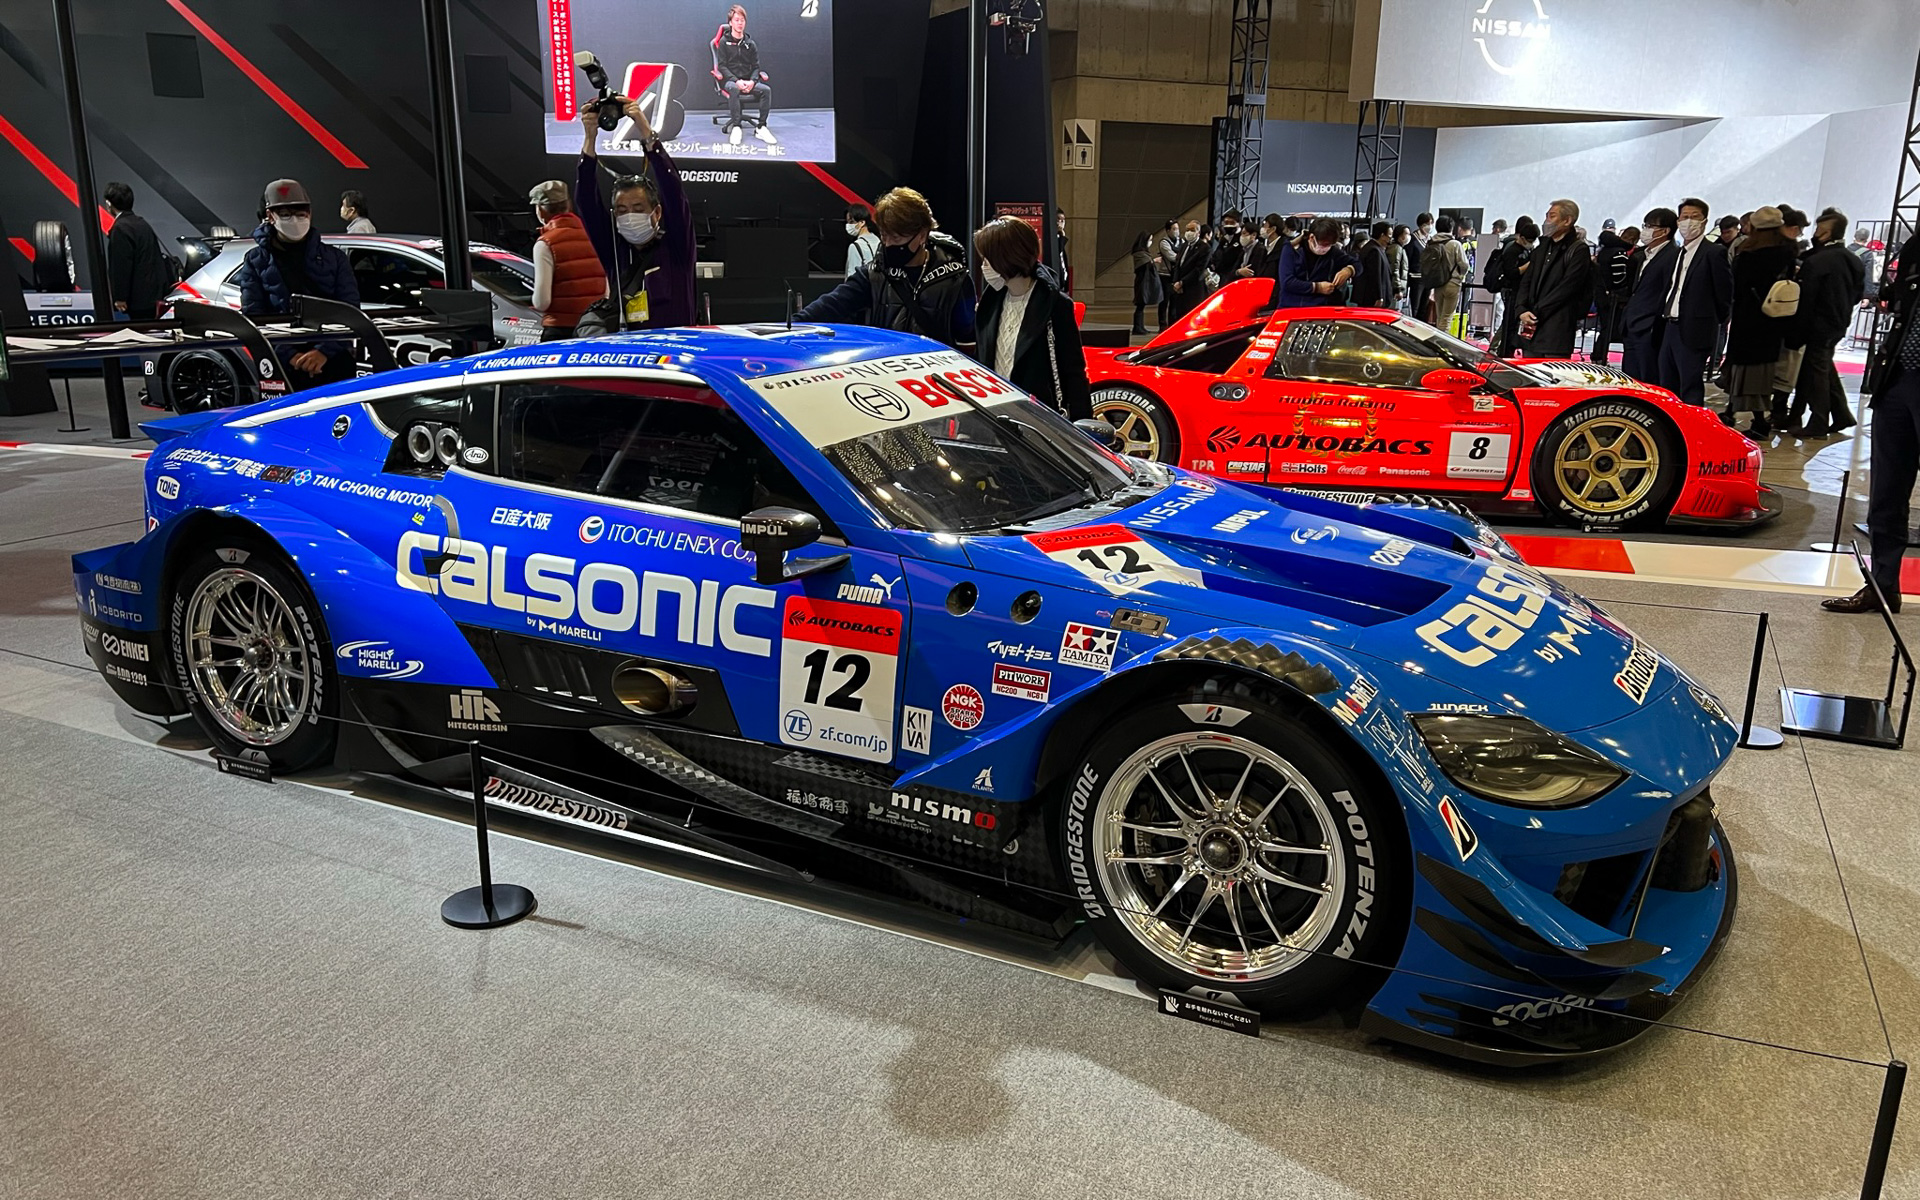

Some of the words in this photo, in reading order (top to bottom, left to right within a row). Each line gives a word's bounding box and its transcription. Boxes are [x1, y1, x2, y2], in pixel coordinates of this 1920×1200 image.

[1472, 17, 1551, 38] NISSAN
[678, 170, 739, 182] DGESTONE
[1287, 183, 1319, 193] NISSAN
[473, 356, 547, 369] K.HIRAMINE
[566, 353, 657, 365] B.BAGUETTE
[777, 371, 844, 390] nismo
[850, 354, 948, 379] NISSAN
[896, 368, 1014, 408] BOSCH
[1564, 405, 1655, 430] BRIDGESTONE
[1240, 432, 1434, 456] AUTOBACS
[1469, 437, 1491, 460] 8
[1192, 460, 1216, 471] TPR
[1299, 463, 1328, 474] Holts
[1379, 467, 1431, 476] Panasonic
[1699, 461, 1736, 475] Mobil
[158, 478, 178, 496] TONE
[312, 475, 340, 489] TAN
[341, 480, 386, 501] CHONG
[387, 490, 433, 508] MOTOR
[490, 507, 552, 531] 日産大阪
[1129, 490, 1215, 528] NISSAN
[1559, 500, 1650, 523] POTENZA
[741, 523, 788, 536] IMPUL
[1212, 509, 1269, 533] IMPUL
[608, 525, 674, 550] ITOCHU
[676, 532, 718, 556] ENEX
[1077, 545, 1155, 574] 12
[837, 584, 884, 604] PUMA
[97, 604, 143, 622] NOBORITO
[527, 616, 536, 628] by
[558, 627, 602, 641] MARELLI
[807, 616, 895, 637] AUTOBACS
[120, 639, 149, 662] ENKEI
[171, 592, 198, 704] BRIDGESTONE
[358, 648, 395, 661] HIGHLY
[1062, 648, 1110, 667] TAMIYA
[1534, 642, 1563, 663] by
[294, 605, 324, 726] POTENZA
[358, 658, 400, 671] MARELLI
[803, 649, 871, 713] 12
[996, 685, 1018, 696] NC200
[950, 692, 978, 709] NGK
[1331, 682, 1371, 726] Mobil
[1427, 703, 1489, 712] JUNACK
[949, 714, 976, 724] PLUGS
[950, 707, 976, 717] SPARK
[447, 721, 479, 731] HITECH
[480, 723, 508, 732] RESIN
[820, 727, 888, 754] zf.com/jp
[971, 785, 994, 793] ATLANTIC
[484, 776, 628, 831] BRIDGESTONE
[891, 792, 996, 830] nismo
[1066, 763, 1106, 920] BRIDGESTONE
[1332, 790, 1376, 960] POTENZA
[1185, 1002, 1251, 1024] お手を触れないでください
